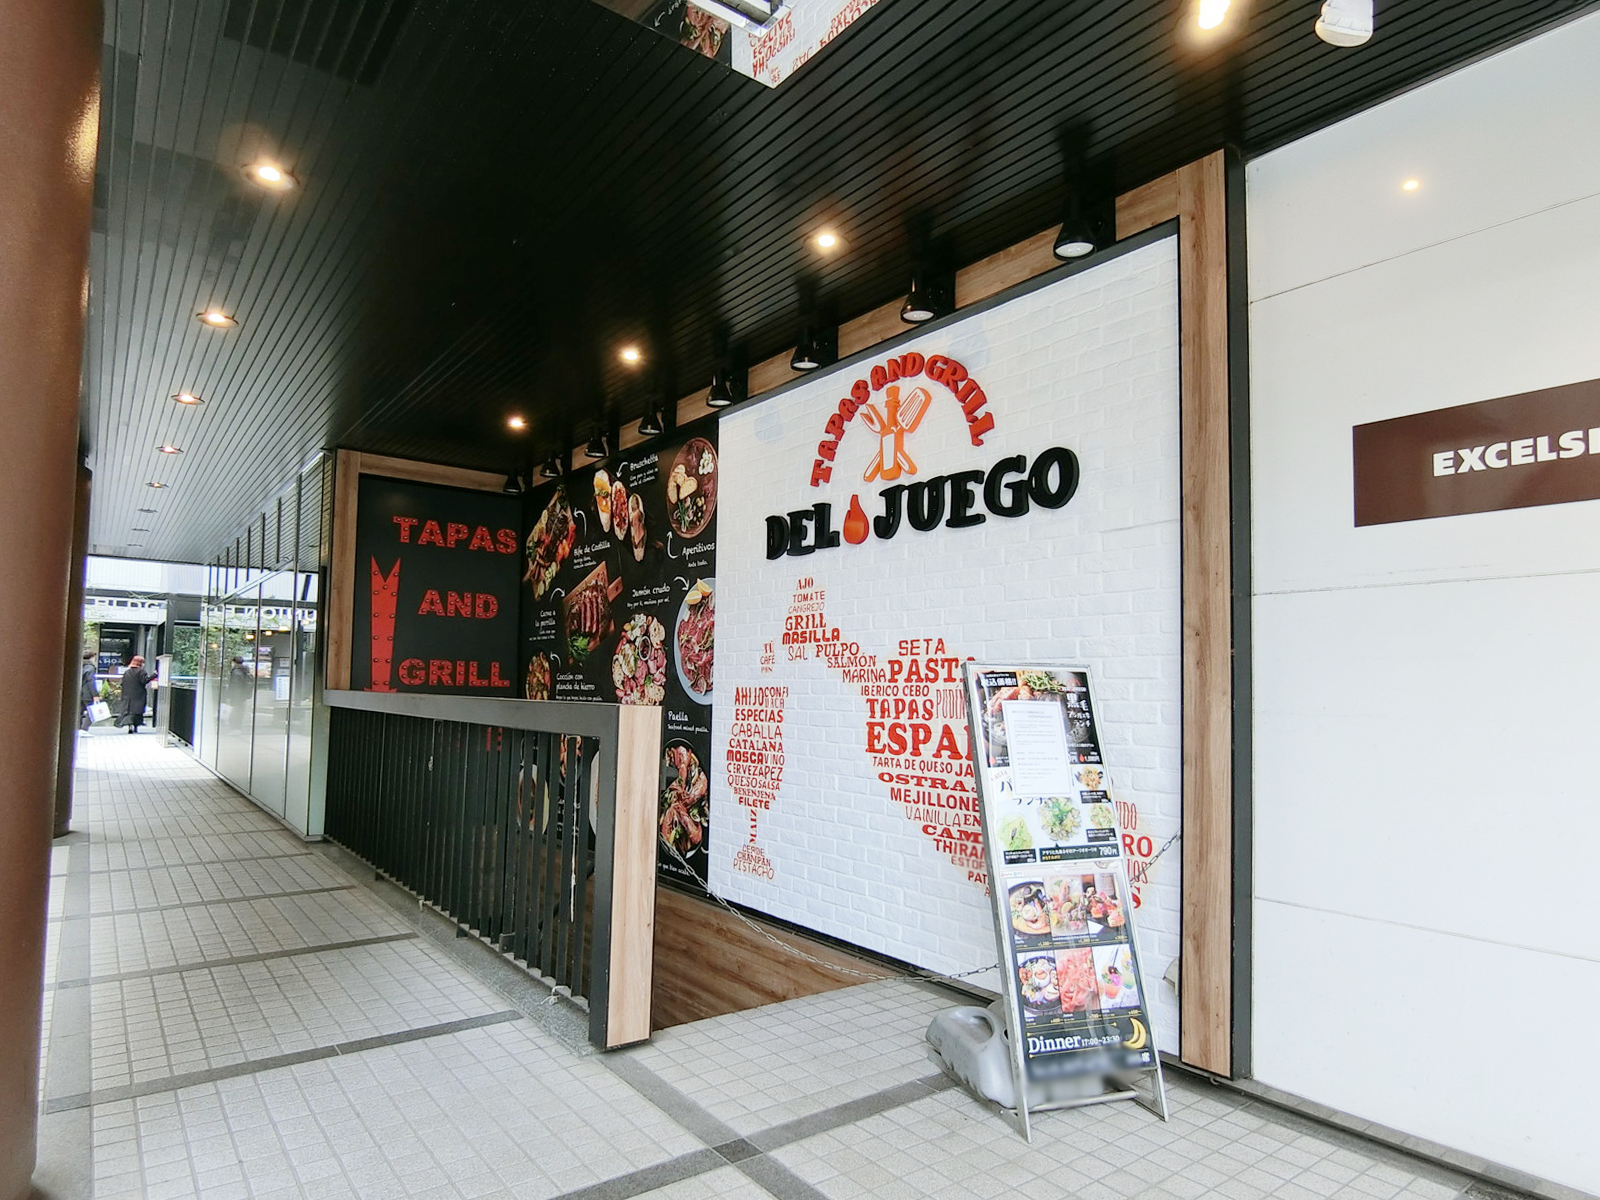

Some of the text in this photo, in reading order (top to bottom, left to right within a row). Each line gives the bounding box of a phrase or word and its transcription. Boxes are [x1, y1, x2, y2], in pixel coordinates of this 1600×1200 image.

[810, 352, 995, 487] TAPAS AND GRILL
[1432, 427, 1600, 477] EXCELSI
[765, 446, 1080, 560] DEL JUEGO
[393, 516, 517, 554] TAPAS
[583, 544, 590, 553] de
[682, 542, 715, 560] Aperitivos
[632, 583, 671, 597] Jamón crudo
[796, 577, 814, 590] AJO
[418, 589, 499, 619] AND
[792, 590, 825, 604] TOMATE
[788, 602, 825, 614] CANGREJO
[785, 613, 827, 631] GRILL
[782, 627, 840, 645] MASILLA
[788, 642, 860, 661] SAL PULPO
[899, 638, 945, 656] SETA
[827, 652, 876, 668] SALMÓN
[398, 658, 510, 687] GRILL
[842, 668, 886, 683] MARINA
[888, 656, 975, 683] PAST
[573, 681, 580, 690] de
[764, 686, 789, 698] CONFI
[861, 681, 930, 696] IBÉRICO CEBO
[734, 686, 764, 706] AHIJO
[668, 710, 689, 721] Paella
[735, 708, 784, 723] ESPECIAS
[866, 698, 934, 720] TAPAS
[732, 722, 783, 740] CABALLA
[729, 738, 784, 754] CATALANA
[726, 749, 785, 766] MOSCA VINO
[872, 756, 953, 774] TARTA DE QUESO
[727, 762, 783, 782] CERVEZA PEZ
[955, 762, 975, 778] JA
[727, 774, 780, 791] QUESO SALSA
[738, 796, 770, 810] FILETE
[890, 787, 980, 813] MEJILLONE
[905, 806, 981, 828] VAINILLA EN
[922, 824, 983, 844] CAM
[1121, 833, 1152, 857] RO
[733, 857, 774, 880] PISTACHO
[951, 855, 986, 870] ESTOF
[968, 871, 989, 884] PAT
[1027, 1035, 1081, 1054] Dinner
